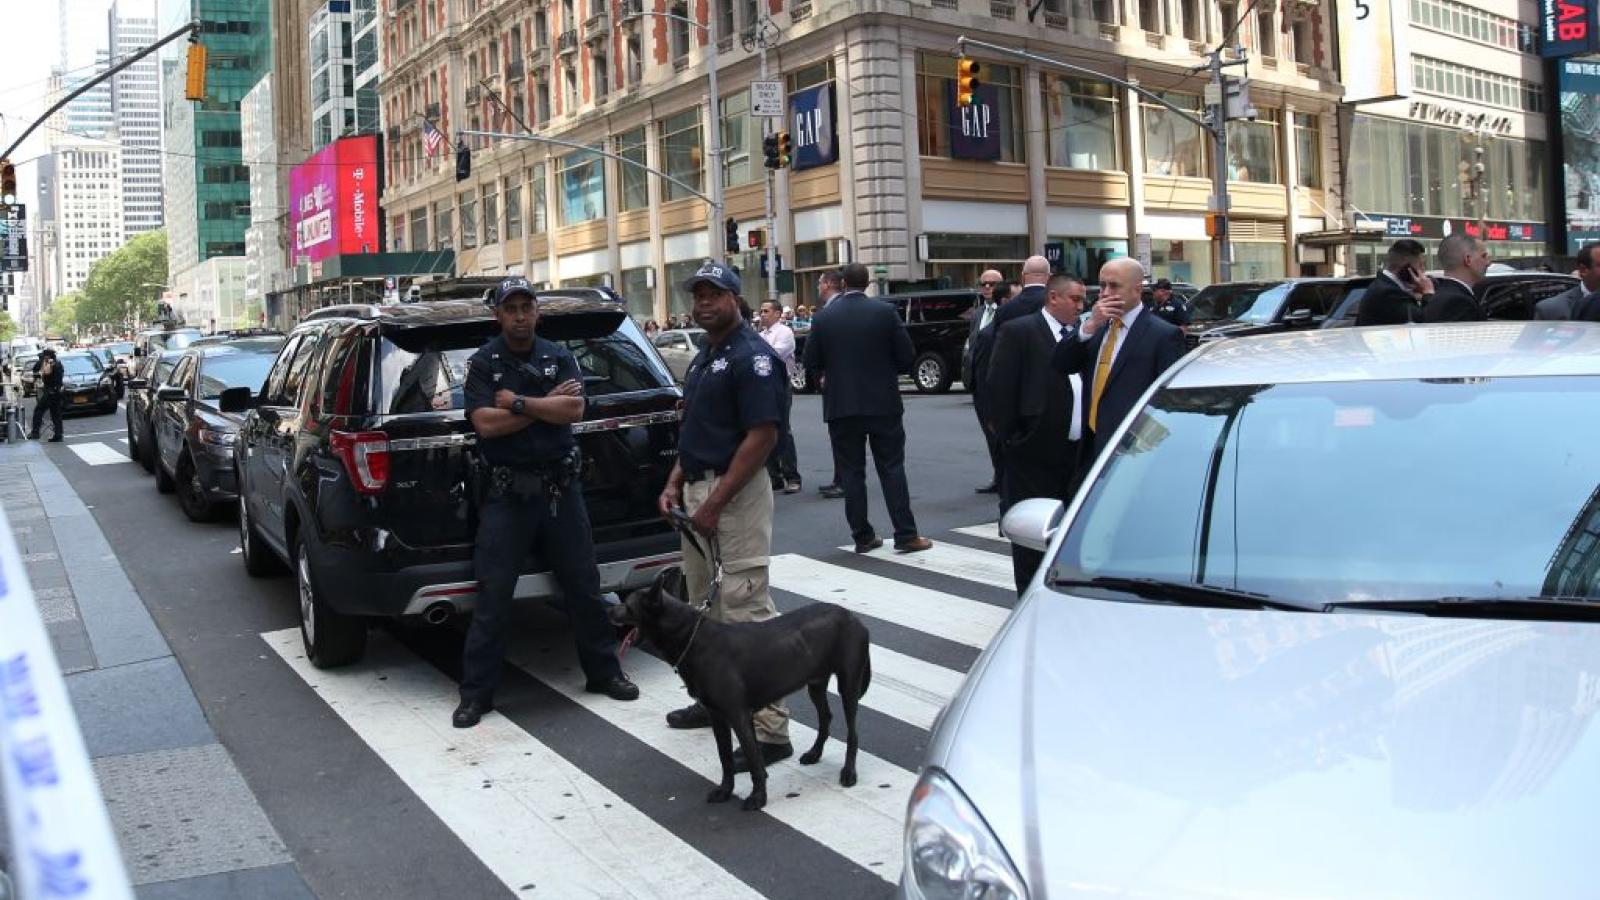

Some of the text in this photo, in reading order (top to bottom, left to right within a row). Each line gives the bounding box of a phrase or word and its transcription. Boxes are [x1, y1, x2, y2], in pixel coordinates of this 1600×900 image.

[1556, 0, 1586, 41] AB
[796, 108, 822, 147] GAP
[962, 104, 990, 138] GAP
